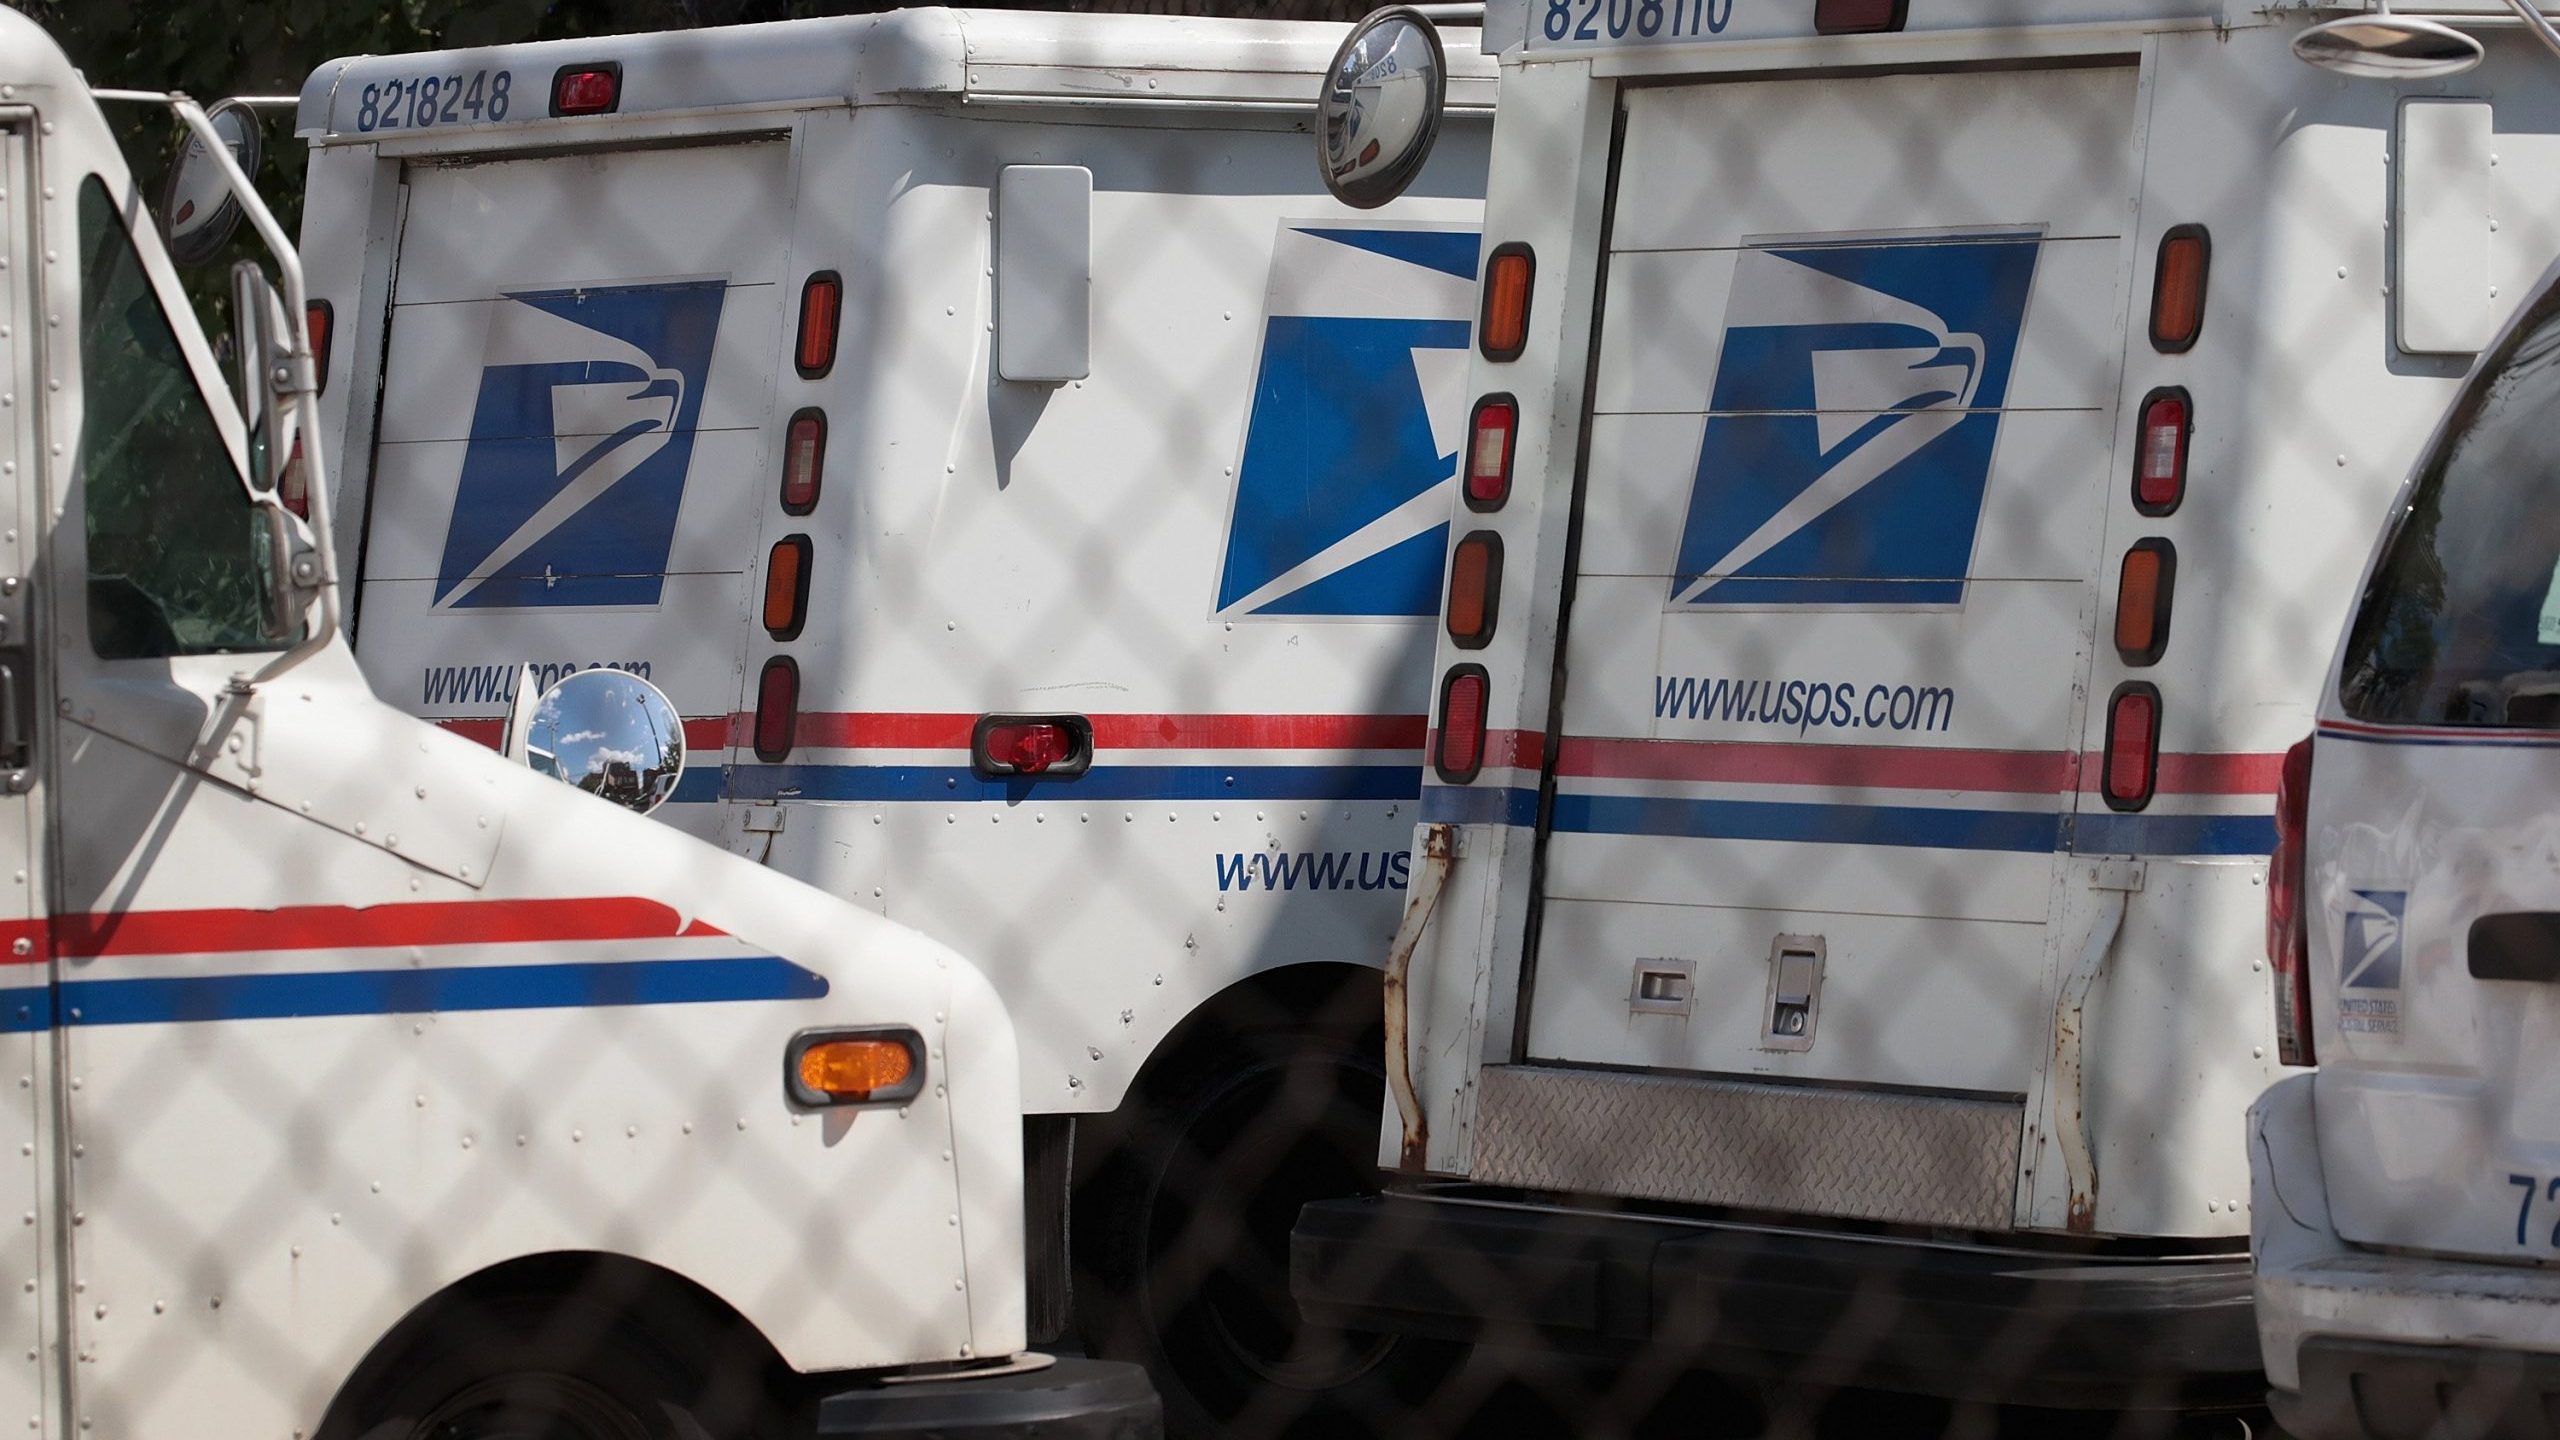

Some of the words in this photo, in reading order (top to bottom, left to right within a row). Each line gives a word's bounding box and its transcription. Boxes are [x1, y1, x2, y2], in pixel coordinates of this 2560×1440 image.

[358, 70, 511, 132] 8218248
[1655, 676, 1954, 738] www.usps.com
[1215, 850, 1412, 891] www.us
